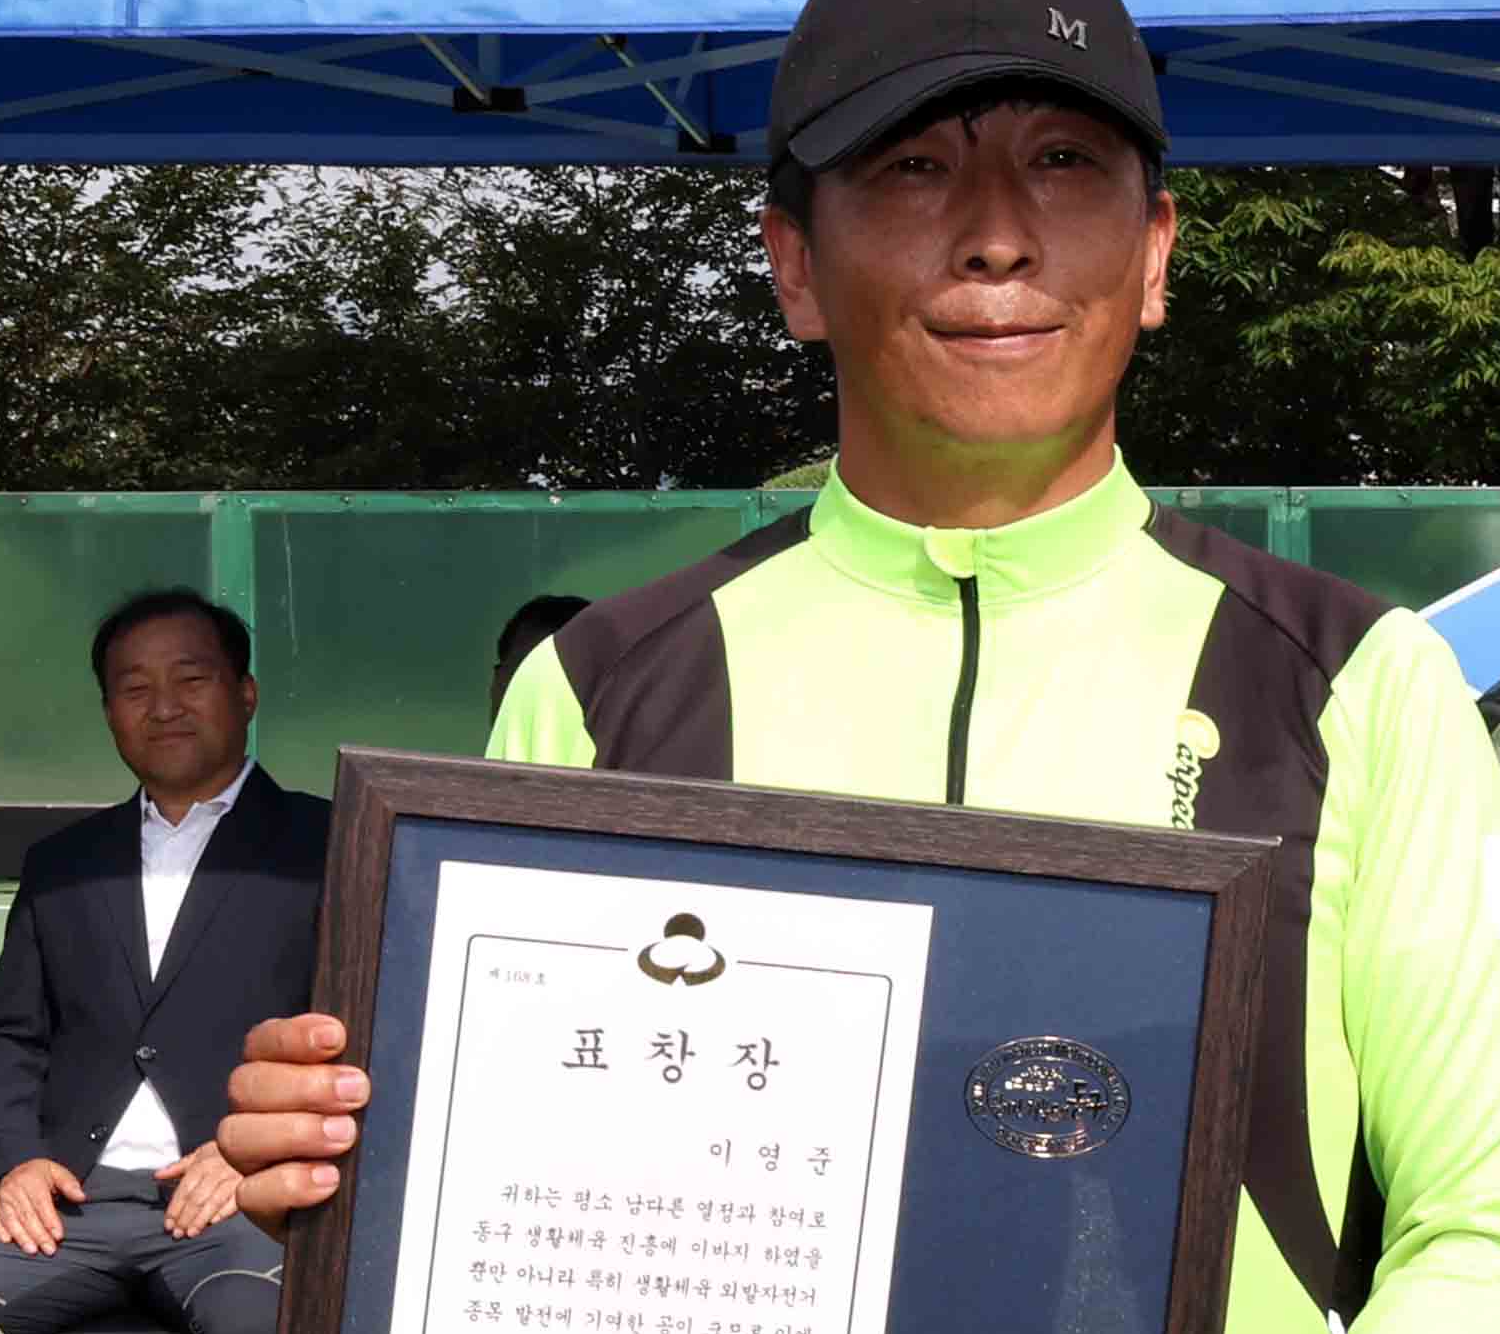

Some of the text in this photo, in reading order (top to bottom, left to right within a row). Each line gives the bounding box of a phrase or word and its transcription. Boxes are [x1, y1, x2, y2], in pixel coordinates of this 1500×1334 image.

[1047, 7, 1088, 51] M
[501, 1183, 826, 1228] 귀하는 평소 남다른 열정과 참여로
[473, 1220, 822, 1270] 동구 생활체육 진흥에 이바지 하였을
[516, 1263, 574, 1288] 아니라
[635, 1274, 712, 1300] 생활체육
[719, 1279, 817, 1307] 외발자전거
[464, 1299, 503, 1323] 종목
[515, 1304, 573, 1330] 발전에
